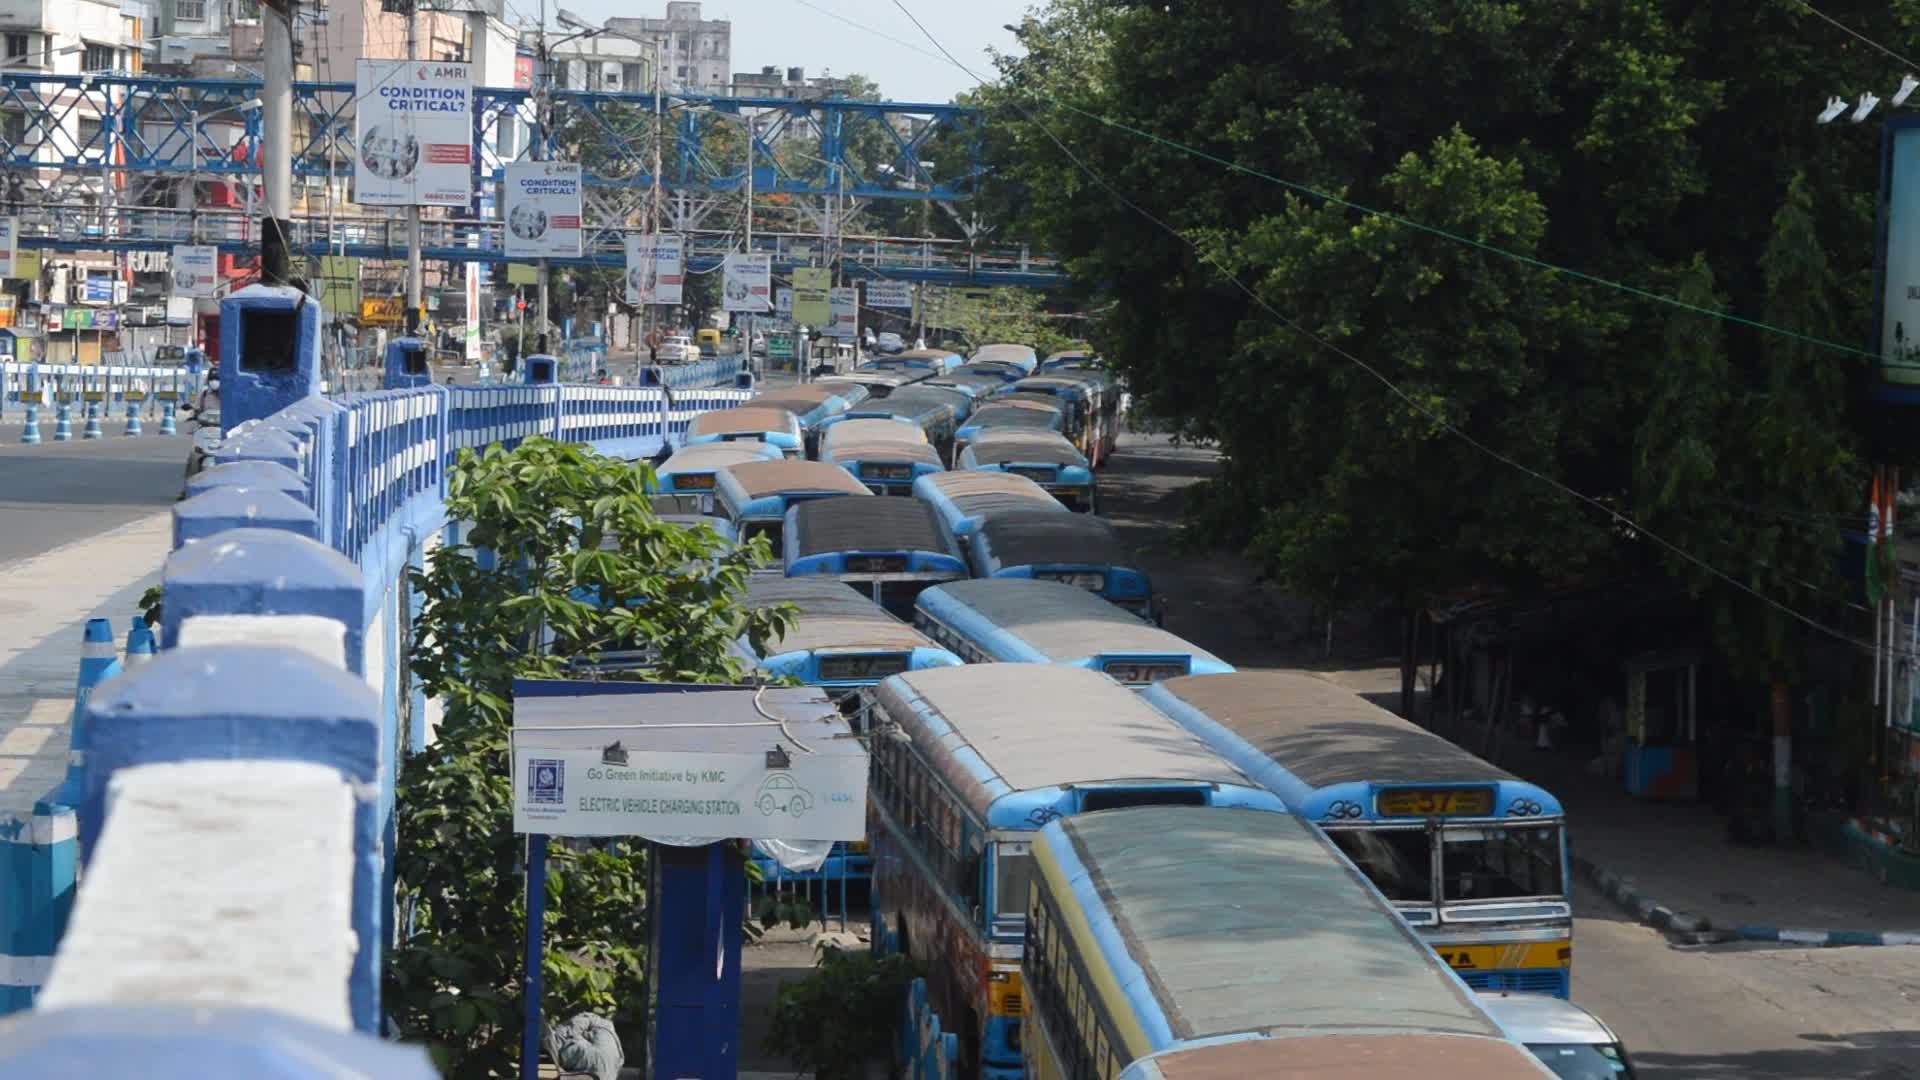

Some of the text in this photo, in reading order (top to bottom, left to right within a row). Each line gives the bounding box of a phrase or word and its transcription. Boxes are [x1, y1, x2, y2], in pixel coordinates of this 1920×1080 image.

[434, 67, 467, 79] AMRI
[380, 87, 465, 99] CONDITION
[388, 99, 465, 112] CRITICAL?
[520, 179, 577, 187] CONDITION
[587, 767, 727, 784] Go Green Initiative by KMC
[579, 797, 741, 816] ELECTRIC VEHICLE CHARGING STATION
